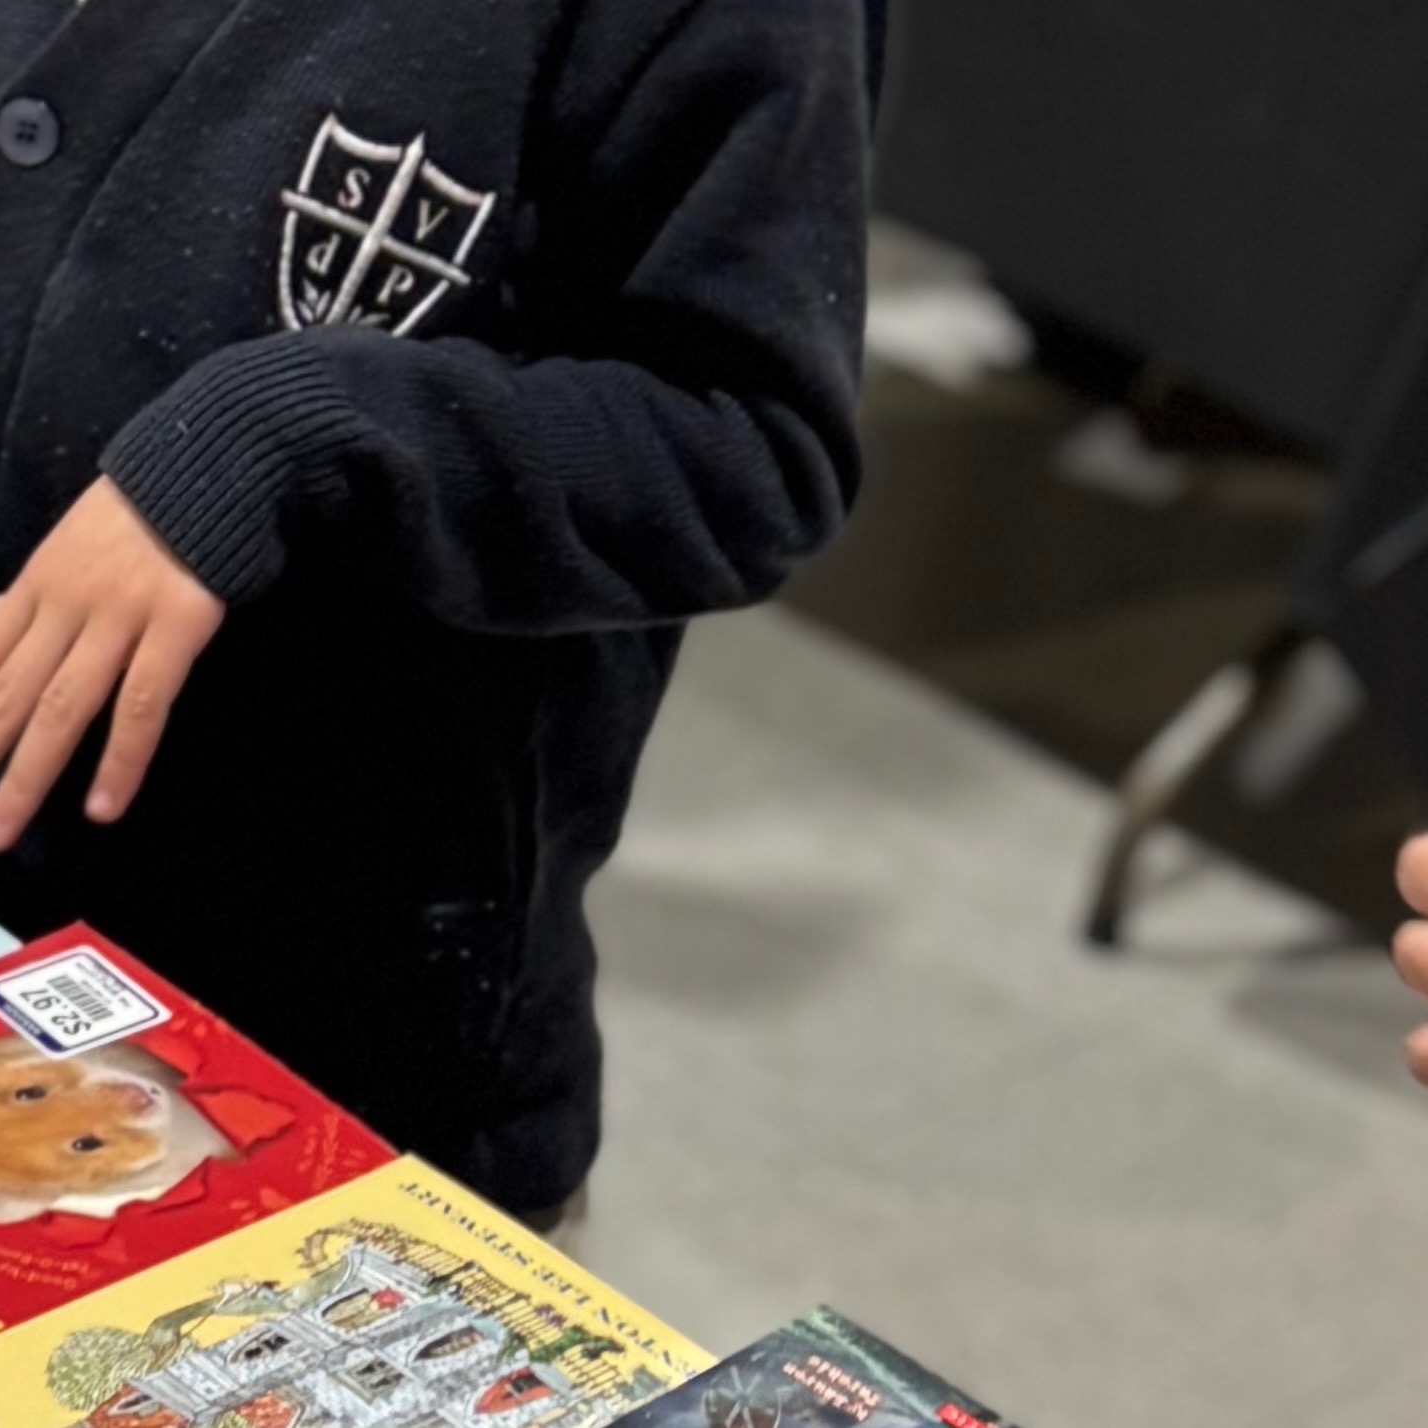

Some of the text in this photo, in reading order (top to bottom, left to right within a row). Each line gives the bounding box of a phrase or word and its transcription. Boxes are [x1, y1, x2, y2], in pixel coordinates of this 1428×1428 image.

[338, 168, 371, 208] S
[20, 986, 93, 1037] $2.97
[400, 1180, 533, 1266] STEWART
[533, 1268, 591, 1305] LEE
